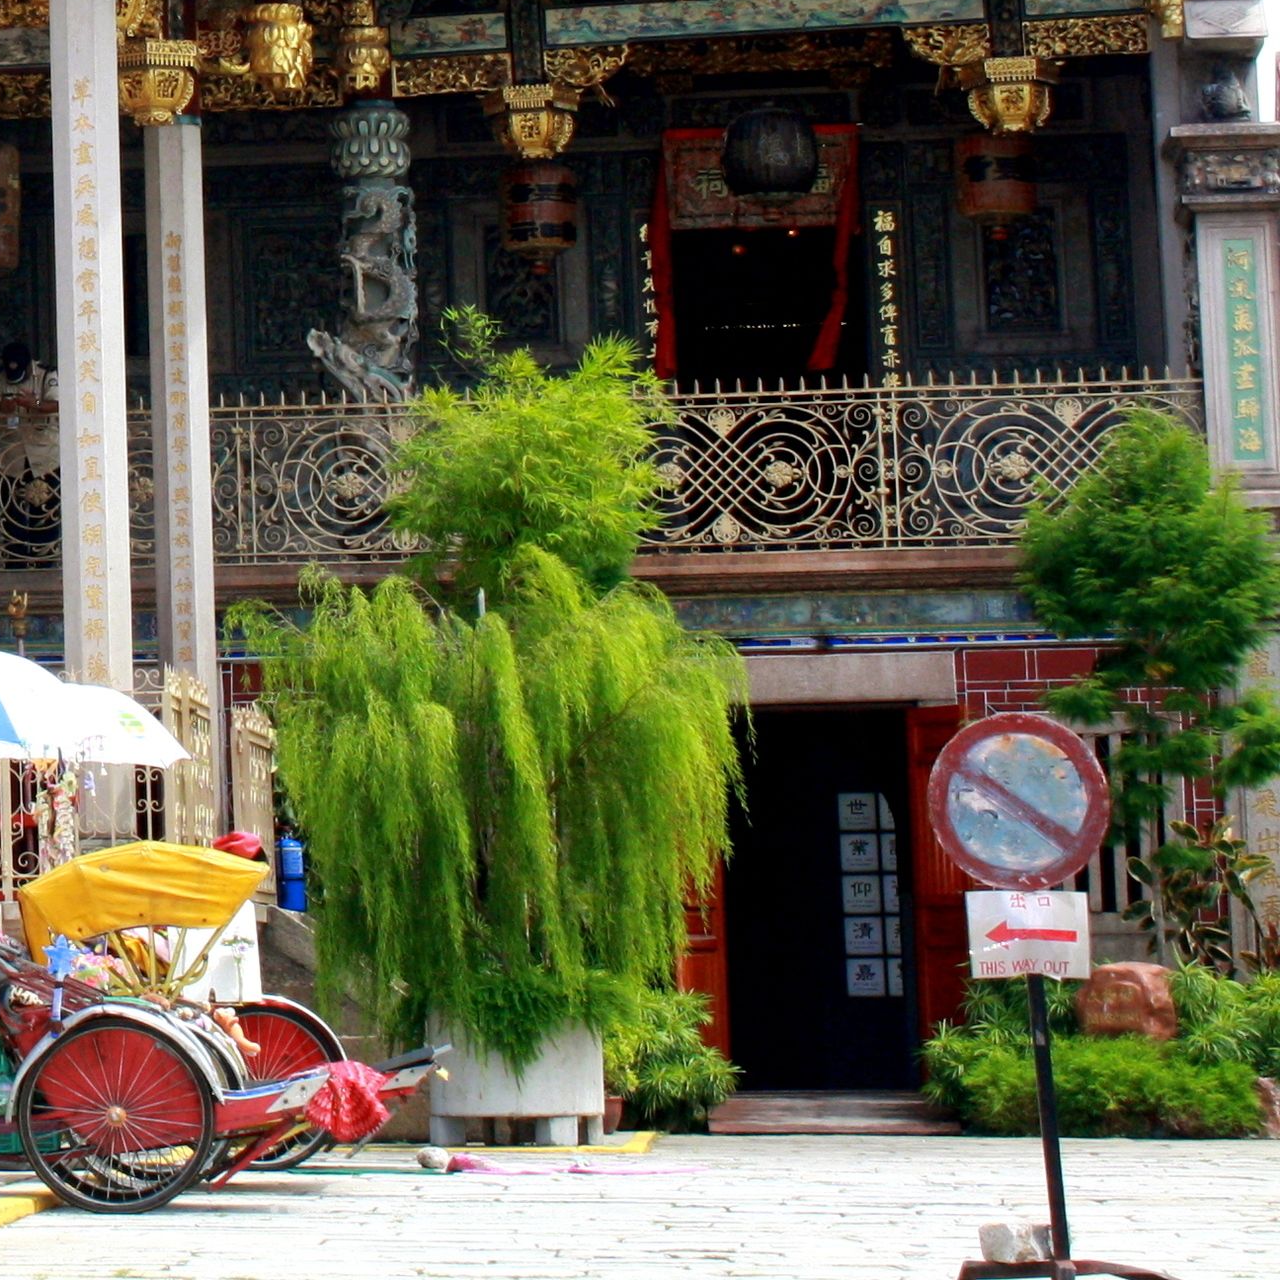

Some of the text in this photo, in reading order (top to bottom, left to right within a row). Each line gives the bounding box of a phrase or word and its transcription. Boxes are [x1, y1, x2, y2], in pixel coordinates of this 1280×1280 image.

[1010, 894, 1051, 909] 出口
[979, 959, 1070, 975] THIS WAY OUT
